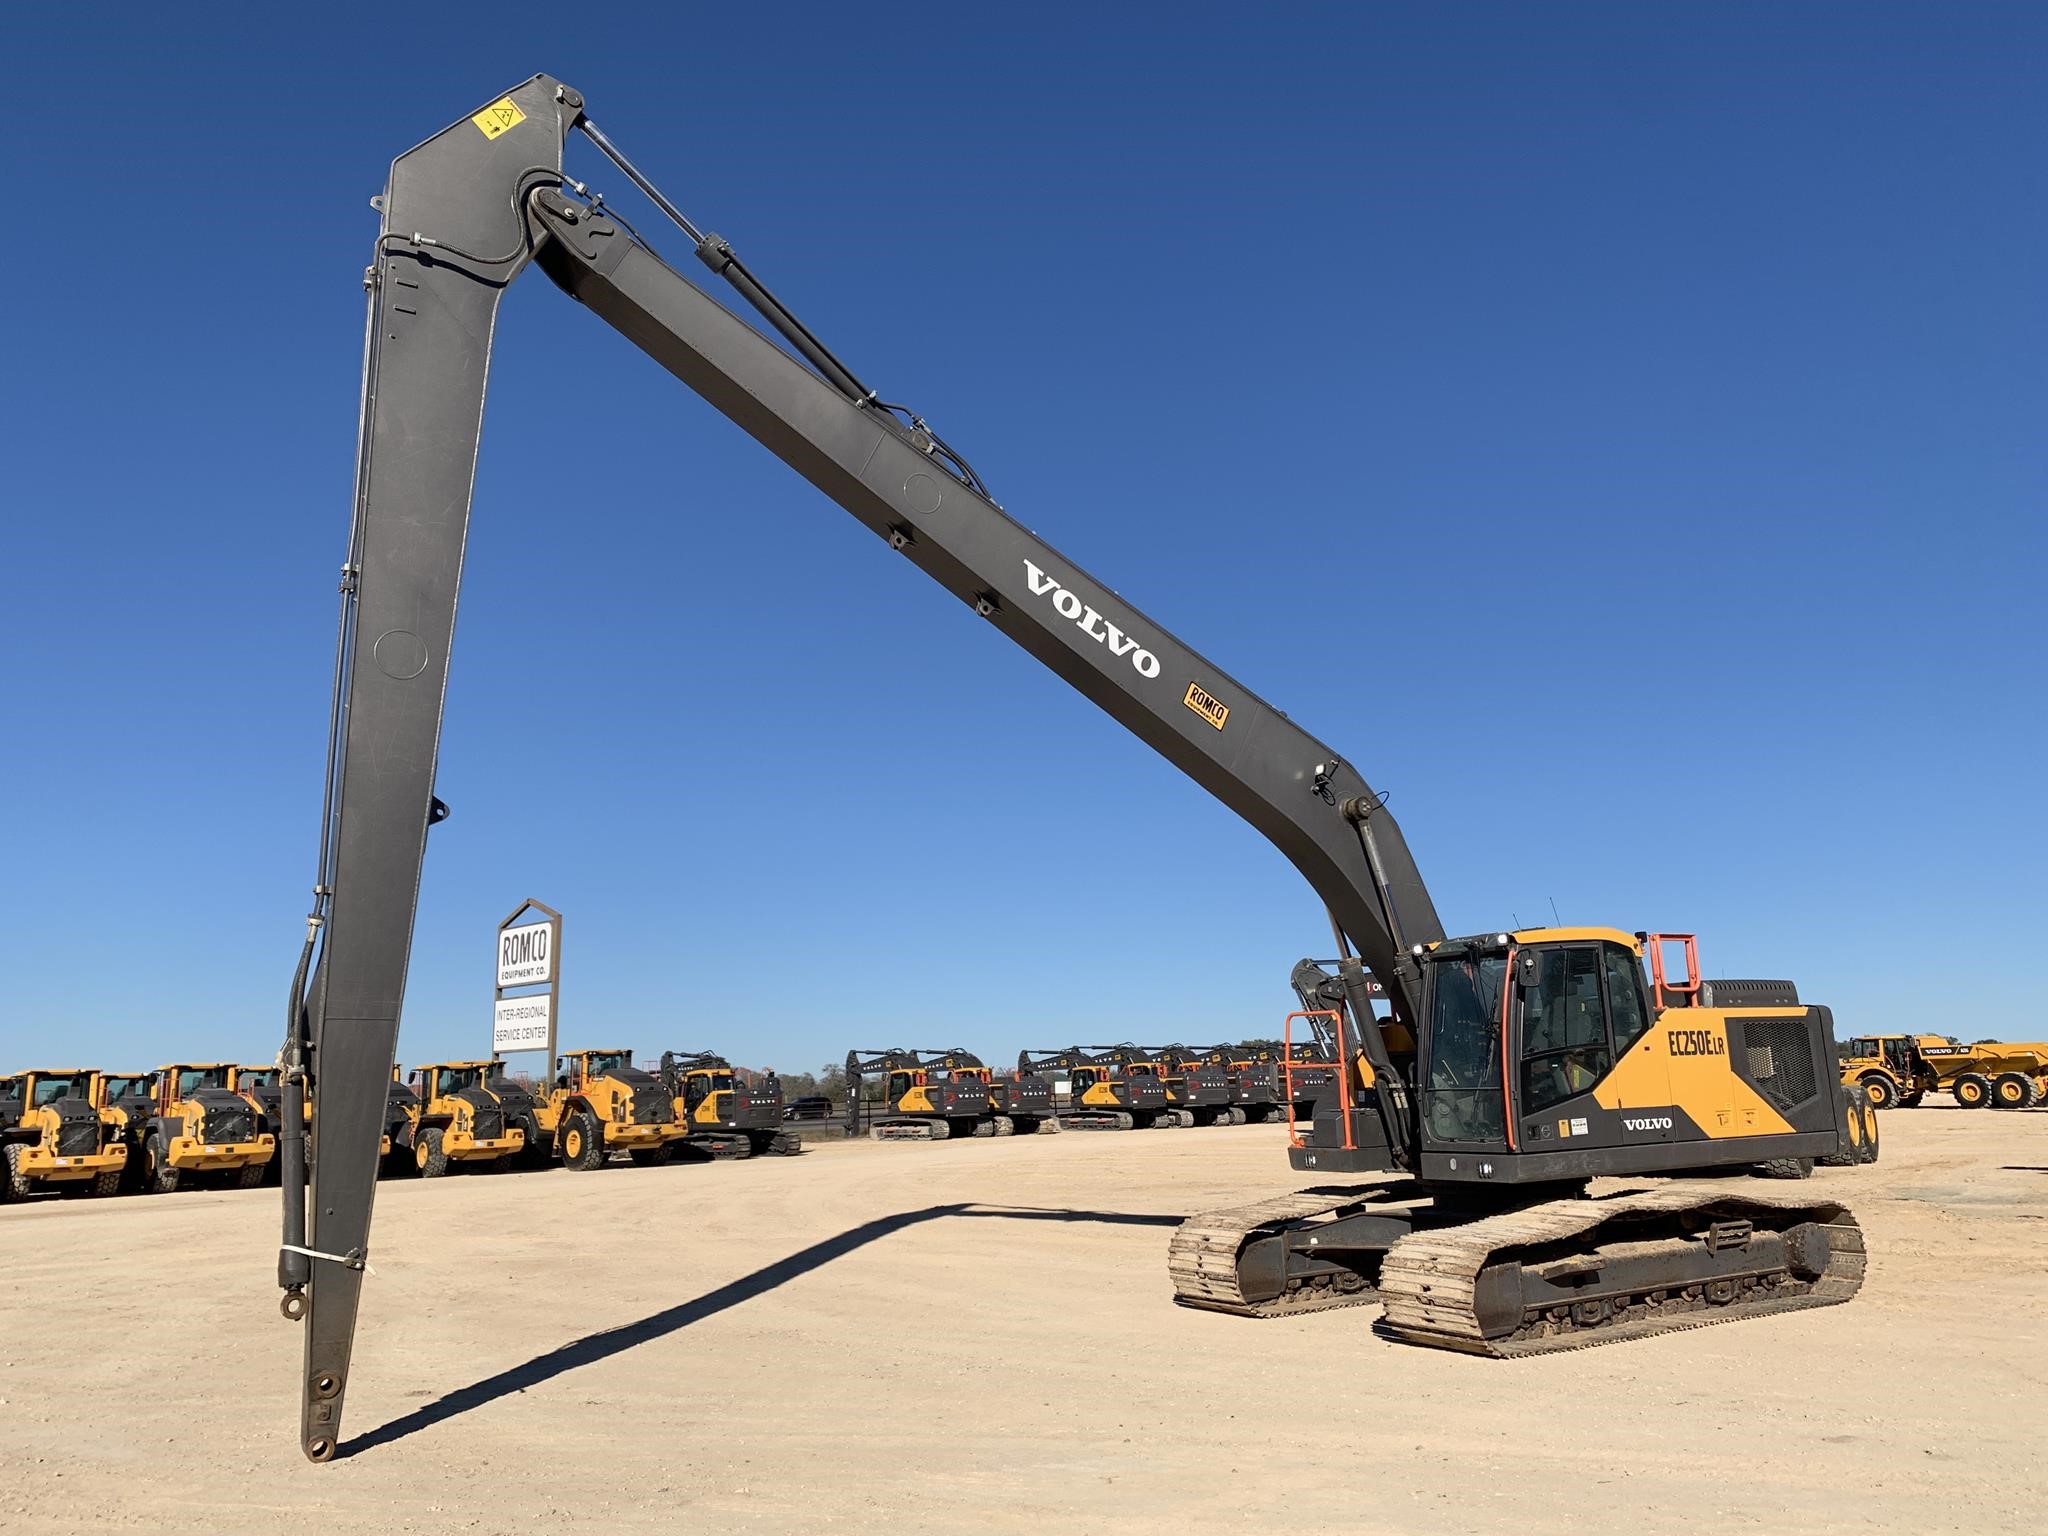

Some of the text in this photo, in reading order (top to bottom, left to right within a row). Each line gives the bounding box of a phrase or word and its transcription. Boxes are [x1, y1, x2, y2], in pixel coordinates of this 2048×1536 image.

[1023, 558, 1161, 679] VOLVO
[1190, 687, 1225, 720] ROMCO
[502, 929, 547, 967] ROMCO
[501, 966, 546, 980] EQUIPMENT CO.
[496, 1006, 547, 1021] INTER-REGIONAL
[495, 1026, 546, 1042] SERVICE CENTER
[1623, 1117, 1672, 1131] VOLVO
